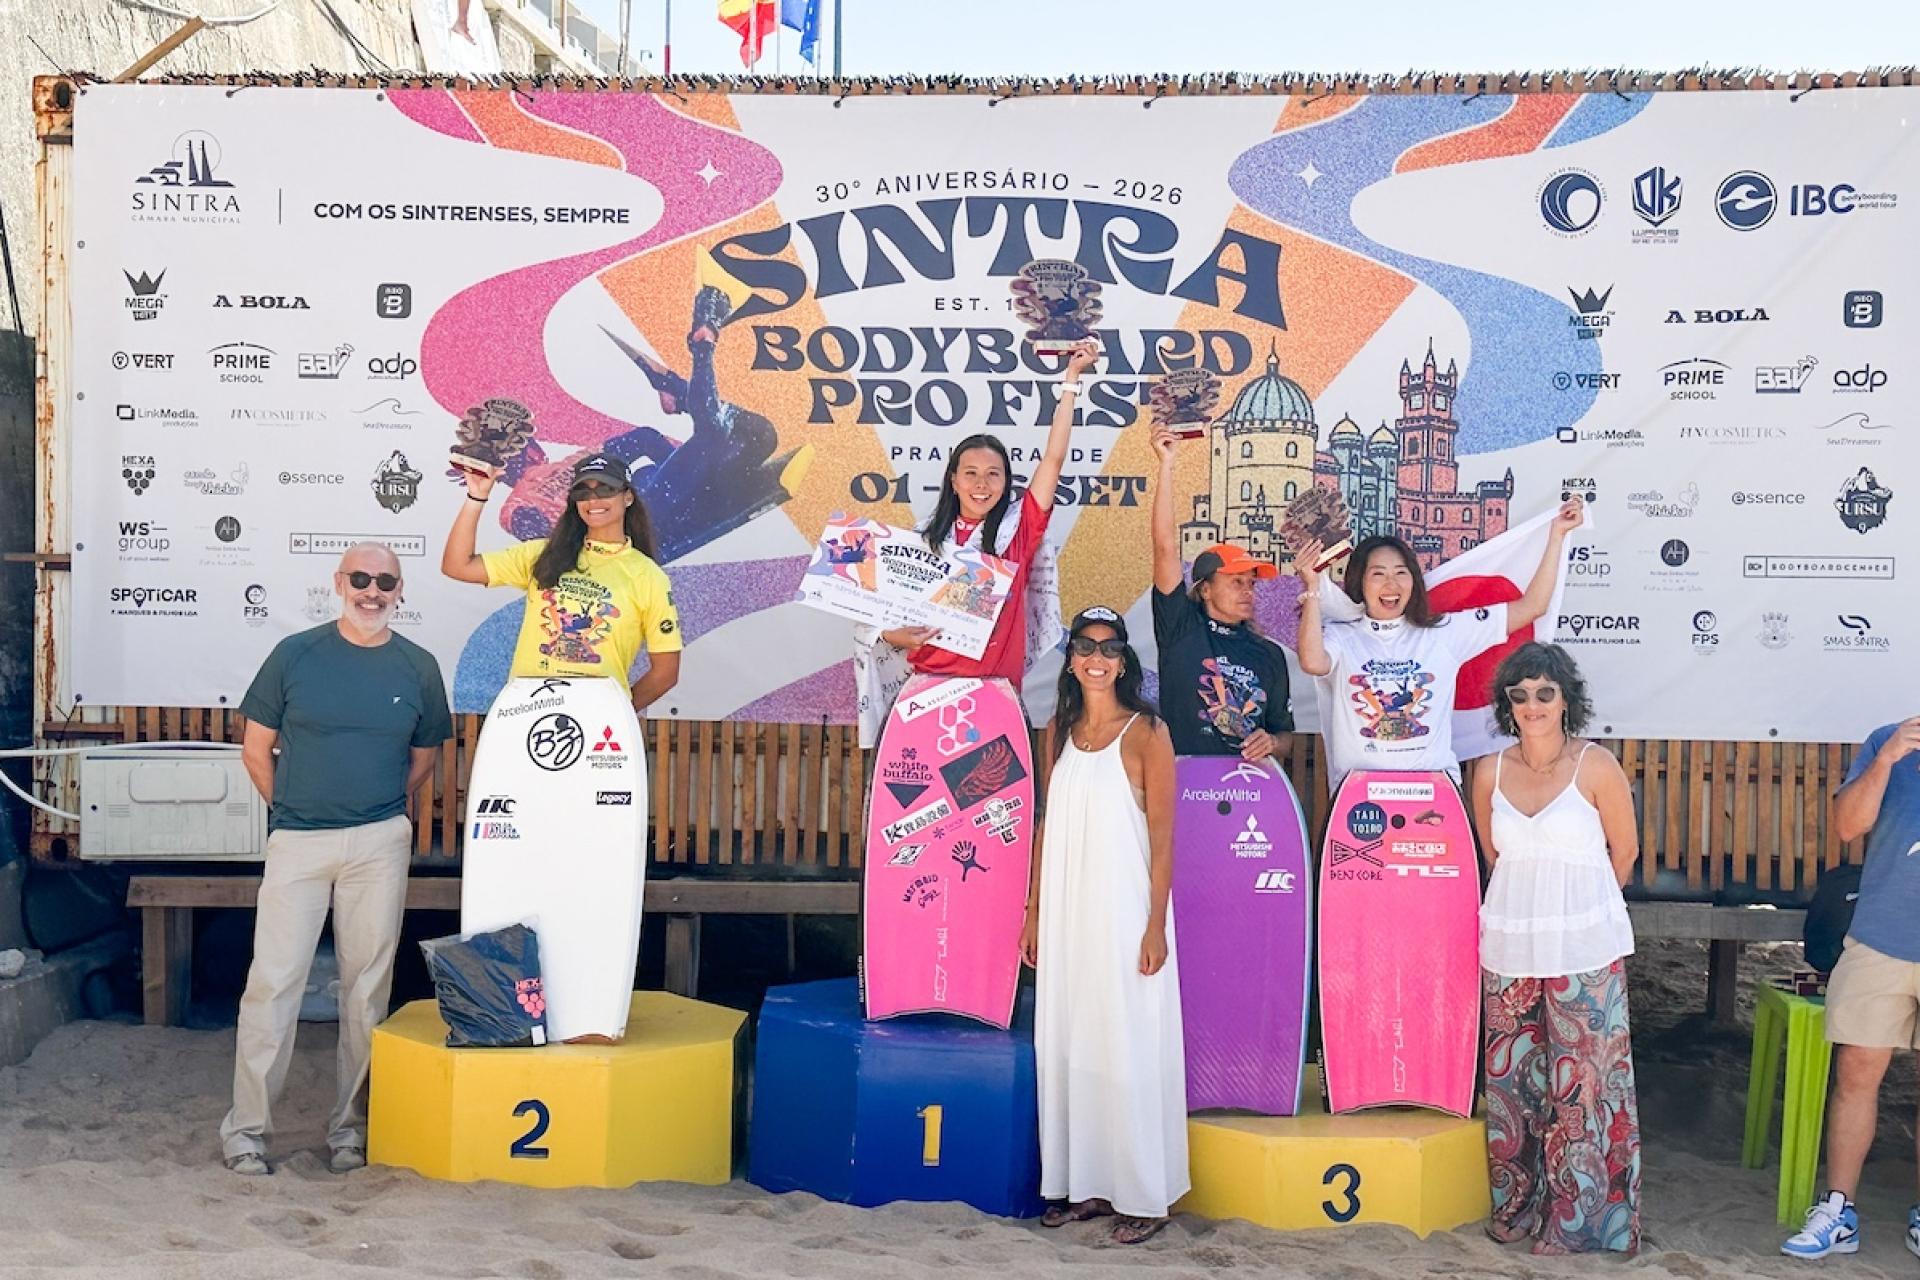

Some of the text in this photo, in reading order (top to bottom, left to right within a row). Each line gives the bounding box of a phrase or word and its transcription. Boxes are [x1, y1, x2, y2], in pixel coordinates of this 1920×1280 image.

[876, 168, 1070, 195] ANIVERSÁRIO
[1113, 179, 1183, 205] 2026
[131, 193, 241, 213] SINTRA
[1790, 183, 1856, 216] IBC
[182, 215, 241, 224] MUNICIPAL
[314, 203, 630, 225] COM OS SINTRENSES, SEMPRE
[709, 194, 1288, 331] SINTRA
[125, 297, 164, 310] MEGA
[213, 295, 311, 310] A BOLA
[934, 298, 990, 311] EST.
[1568, 315, 1611, 328] MEGA
[1664, 307, 1770, 324] A BOLA
[750, 325, 1254, 377] BODYBOARD
[132, 354, 175, 369] VERT
[213, 354, 271, 369] PRIME
[367, 352, 417, 380] adp
[219, 374, 264, 384] SCHOOL
[1576, 373, 1621, 390] VERT
[1663, 370, 1724, 387] PRIME
[1833, 362, 1888, 393] adp
[807, 378, 1152, 428] PRO FES
[1670, 390, 1716, 401] SCHOOL
[121, 455, 156, 465] HEXA
[890, 446, 1103, 462] PRAI RADE
[1055, 474, 1147, 507] SET
[1562, 478, 1597, 488] HEXA
[119, 521, 150, 536] WS
[118, 537, 170, 552] group
[880, 544, 952, 576] SINTRA
[1568, 562, 1611, 578] roup
[244, 606, 269, 618] FPS
[1691, 633, 1719, 645] FPS
[1823, 635, 1890, 648] SMAS SINTRA
[496, 695, 565, 719] ArcelorMittal
[888, 760, 929, 771] white
[882, 769, 934, 781] buffalo
[1181, 788, 1261, 802] ArcelorMittal
[1354, 809, 1381, 821] TABI
[1230, 842, 1273, 851] MITSUBISHI
[1235, 850, 1268, 859] MOTORS
[510, 1099, 550, 1159] 2
[916, 1104, 944, 1166] 1
[1322, 1163, 1361, 1223] 3
